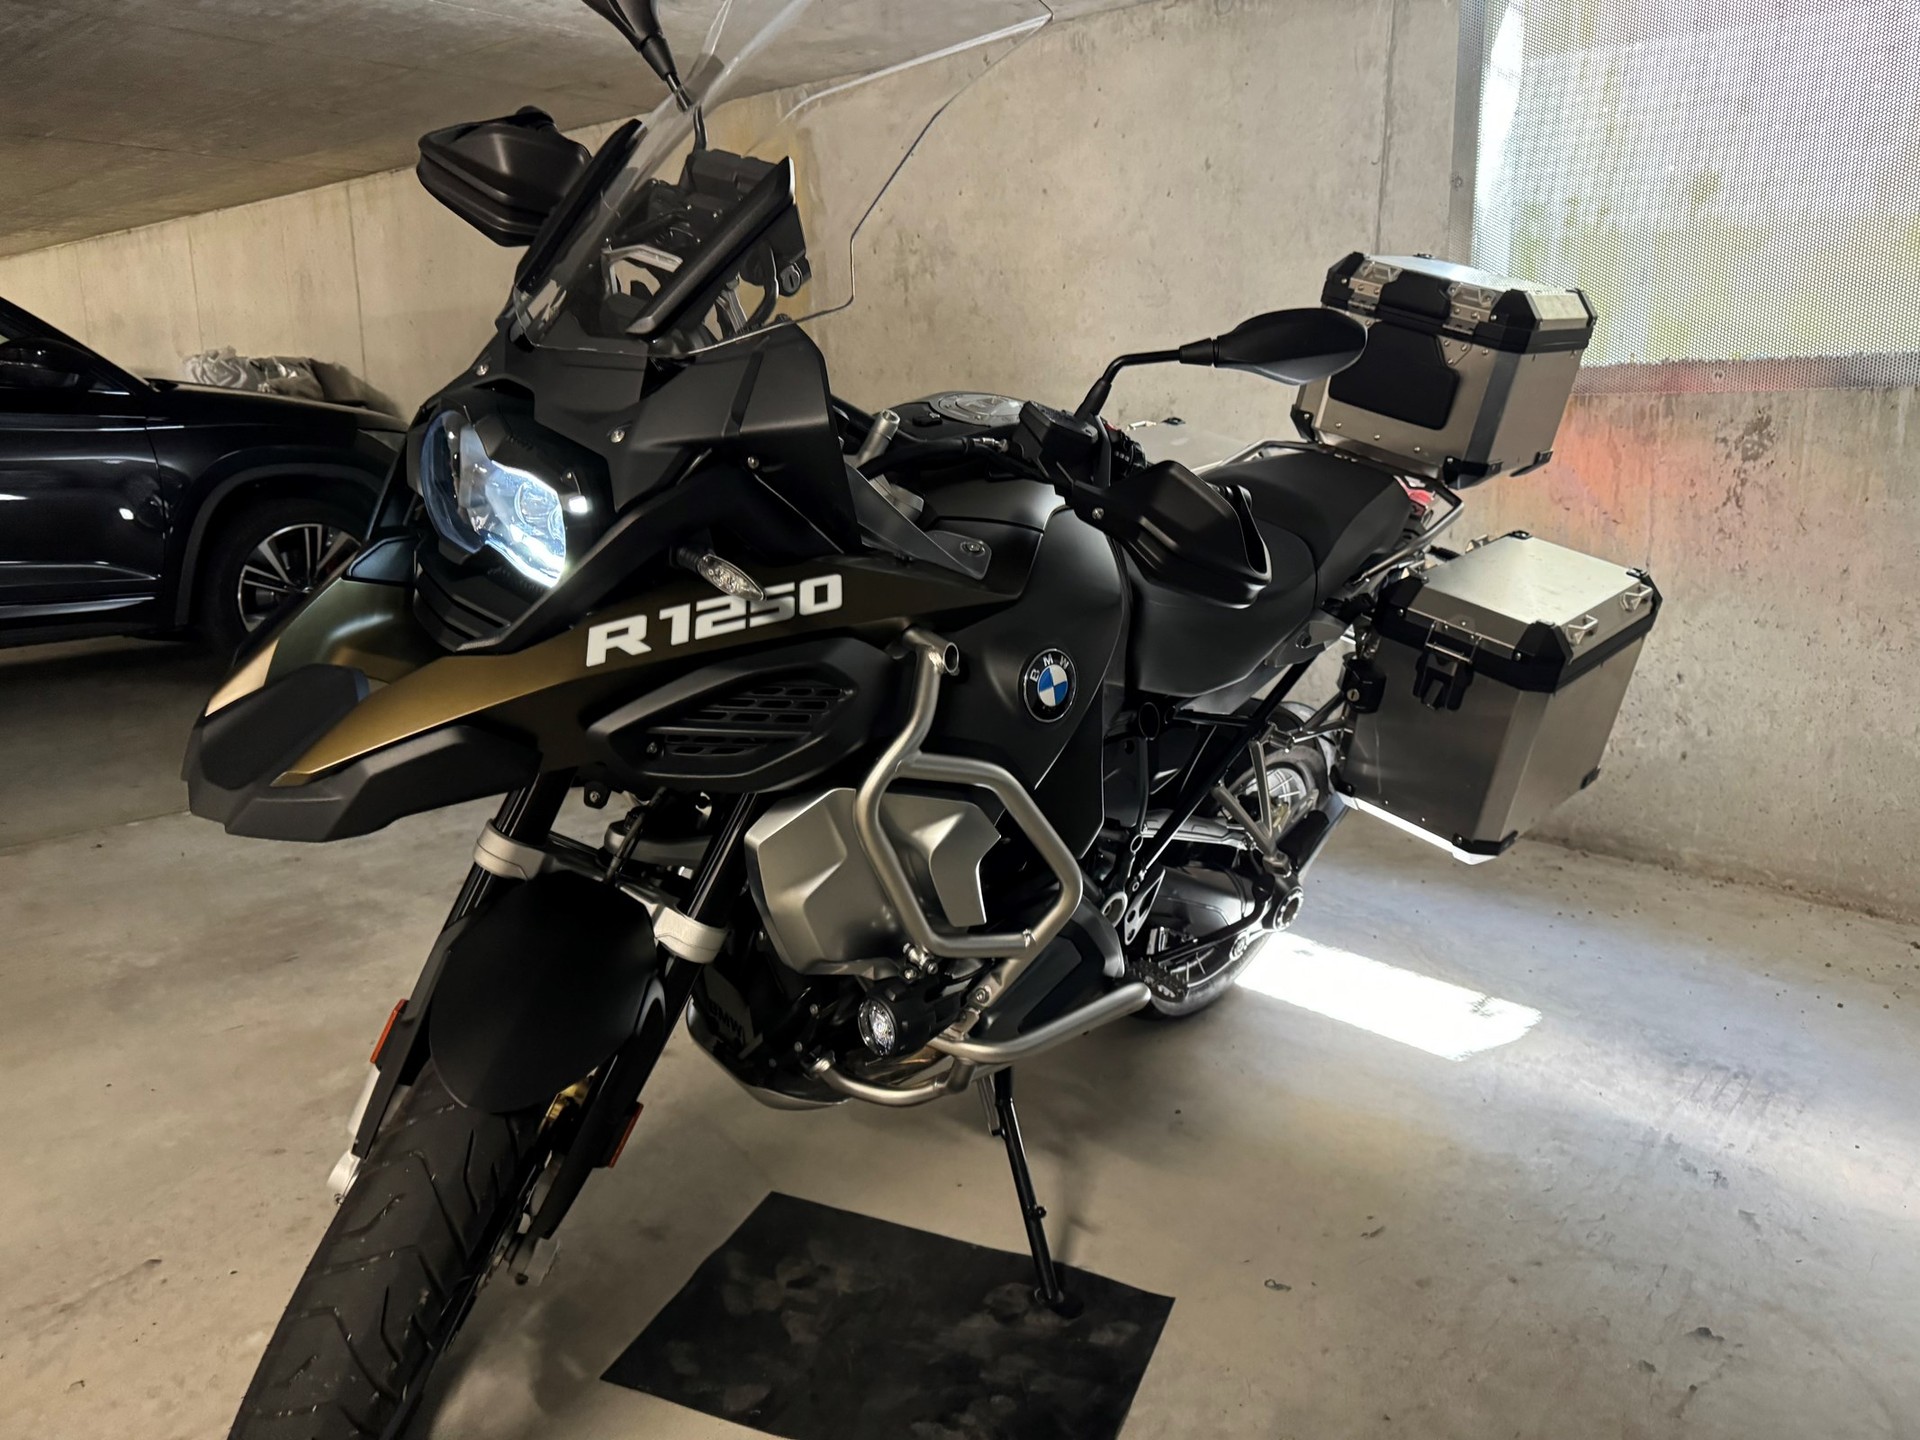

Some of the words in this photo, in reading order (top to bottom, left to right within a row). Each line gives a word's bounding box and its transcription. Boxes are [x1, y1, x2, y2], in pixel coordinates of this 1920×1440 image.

[586, 614, 652, 667] R
[659, 573, 843, 646] 1250
[1029, 653, 1070, 682] BMW
